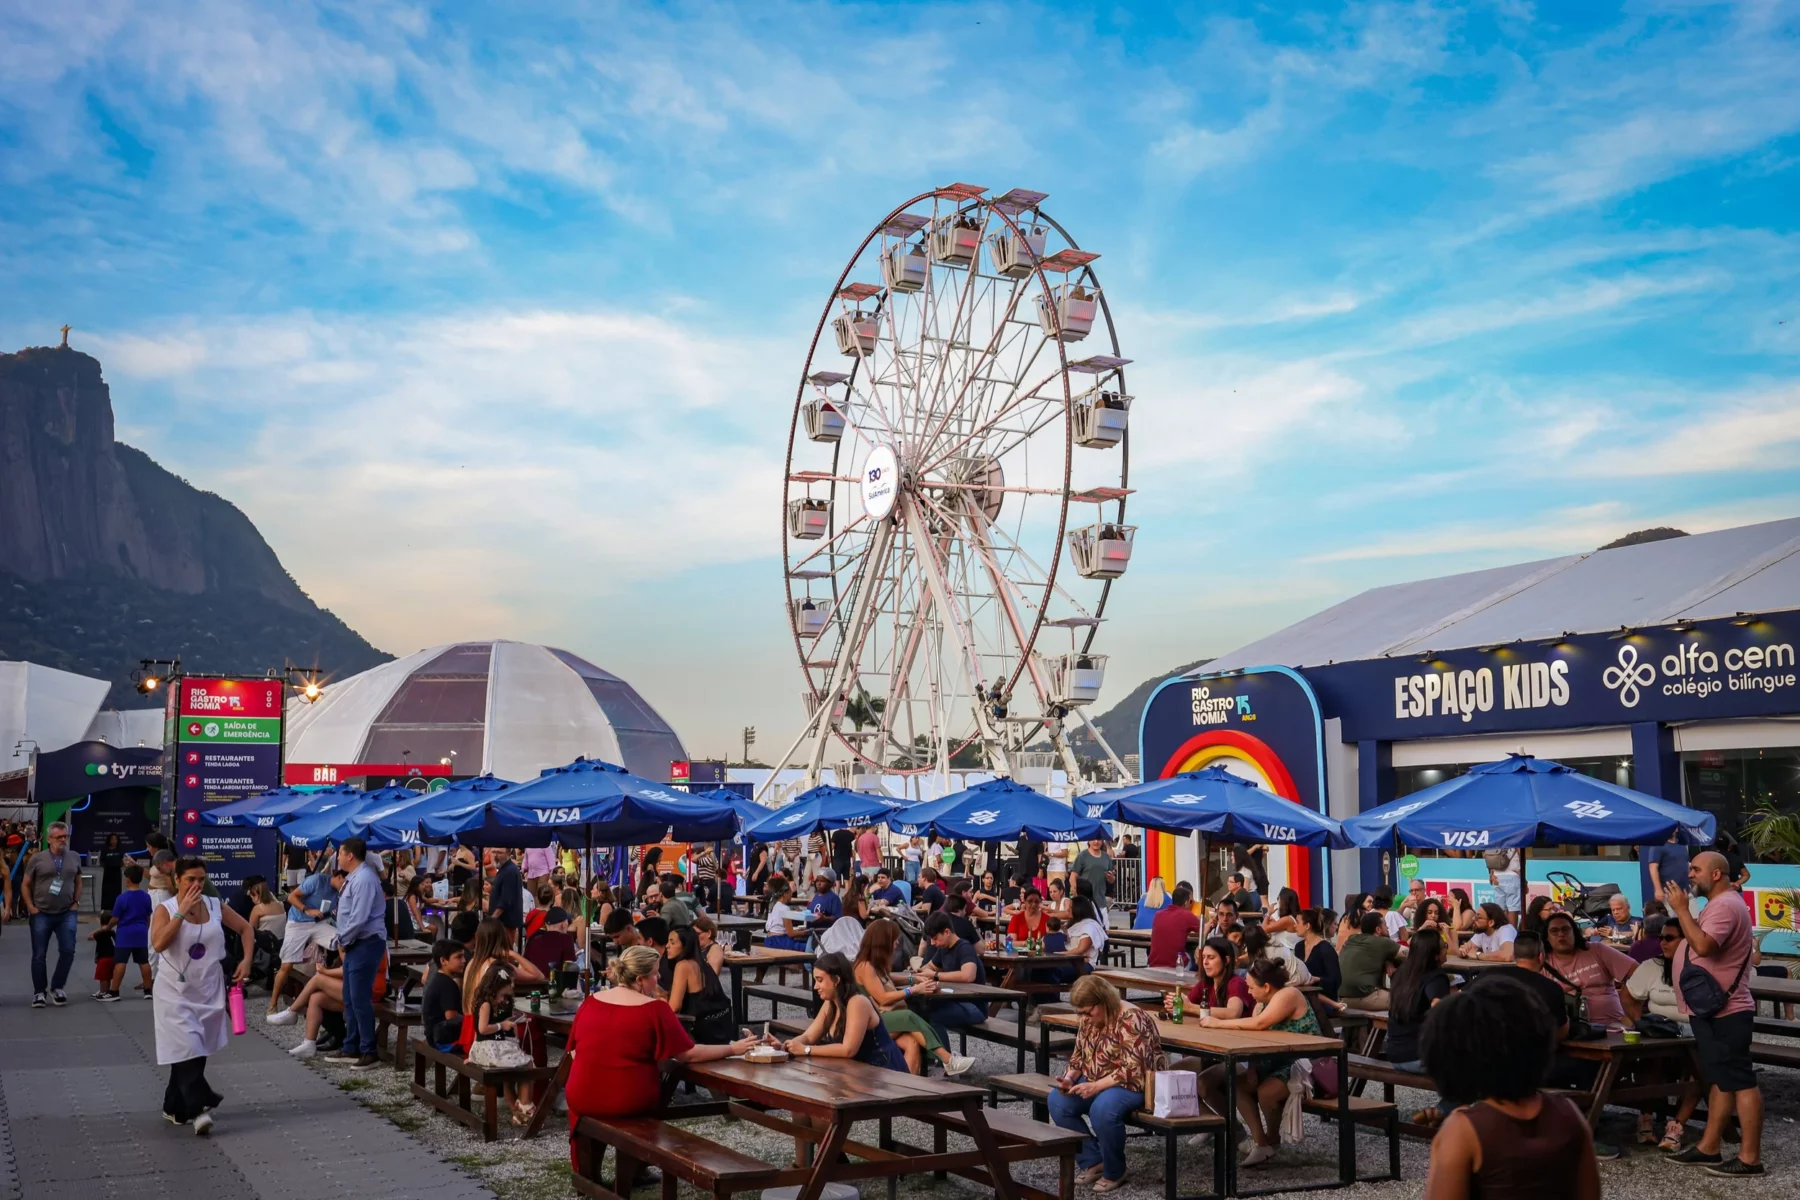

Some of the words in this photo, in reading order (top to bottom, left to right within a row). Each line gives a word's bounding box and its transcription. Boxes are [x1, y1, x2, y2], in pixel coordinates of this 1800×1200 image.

[1661, 642, 1719, 676] alfa
[1724, 643, 1795, 671] cem
[190, 688, 207, 696] RIO
[1395, 667, 1494, 722] ESPAÇO
[1502, 659, 1570, 710] KIDS
[1662, 677, 1722, 698] colégio
[1728, 672, 1797, 693] bilíngue
[190, 695, 227, 704] GASTRO
[1191, 686, 1210, 701] RIO
[190, 702, 221, 710] NOMIA
[1191, 697, 1234, 713] GASTRO
[1235, 694, 1251, 715] 15
[223, 721, 246, 730] SAÍDA
[1192, 710, 1228, 726] NOMIA
[223, 730, 270, 739] EMERGÊNCIA
[111, 762, 137, 779] tyr
[313, 767, 337, 782] BAR
[535, 807, 581, 823] VISA
[1087, 804, 1103, 818] VISA
[217, 816, 234, 825] VISA
[257, 816, 275, 827] VISA
[844, 815, 871, 827] VISA
[399, 829, 423, 844] VIS
[901, 824, 918, 836] VISA
[1052, 831, 1079, 842] VISA
[1260, 823, 1297, 842] VISA
[1440, 830, 1490, 847] VISA
